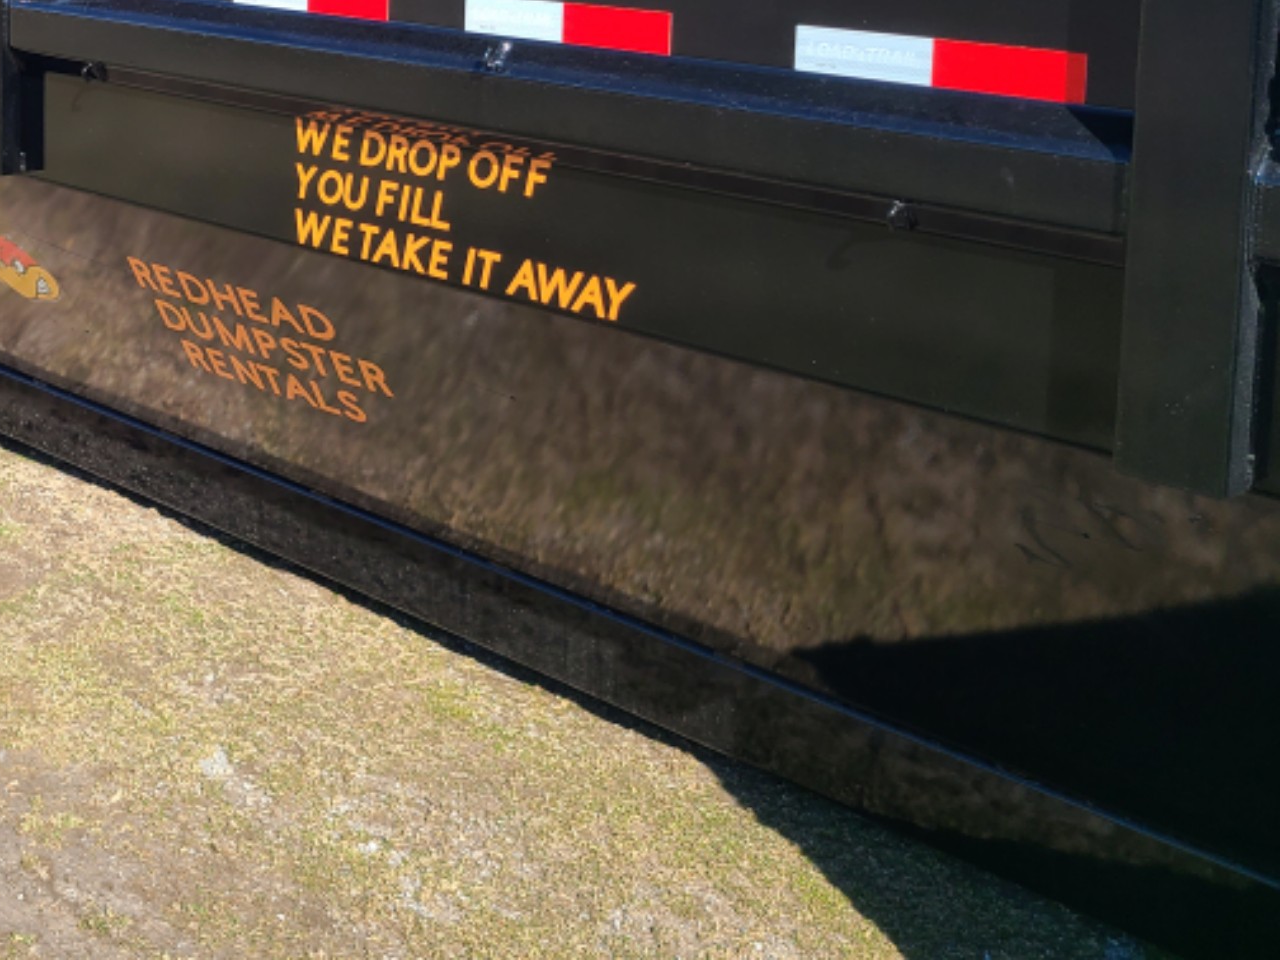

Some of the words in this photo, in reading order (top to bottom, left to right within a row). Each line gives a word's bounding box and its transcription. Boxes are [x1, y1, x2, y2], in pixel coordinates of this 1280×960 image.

[295, 117, 354, 161] WE
[359, 130, 461, 181] DROP
[468, 150, 552, 198] OFF
[295, 162, 369, 211] YOU
[375, 179, 450, 231] FILL
[126, 256, 336, 341] REDHEAD
[295, 208, 354, 256] WE
[358, 223, 453, 280] TAKE
[462, 246, 501, 290] IT
[505, 258, 637, 321] AWAY
[154, 298, 394, 398] DUMPSTER
[181, 339, 368, 423] RENTALS
